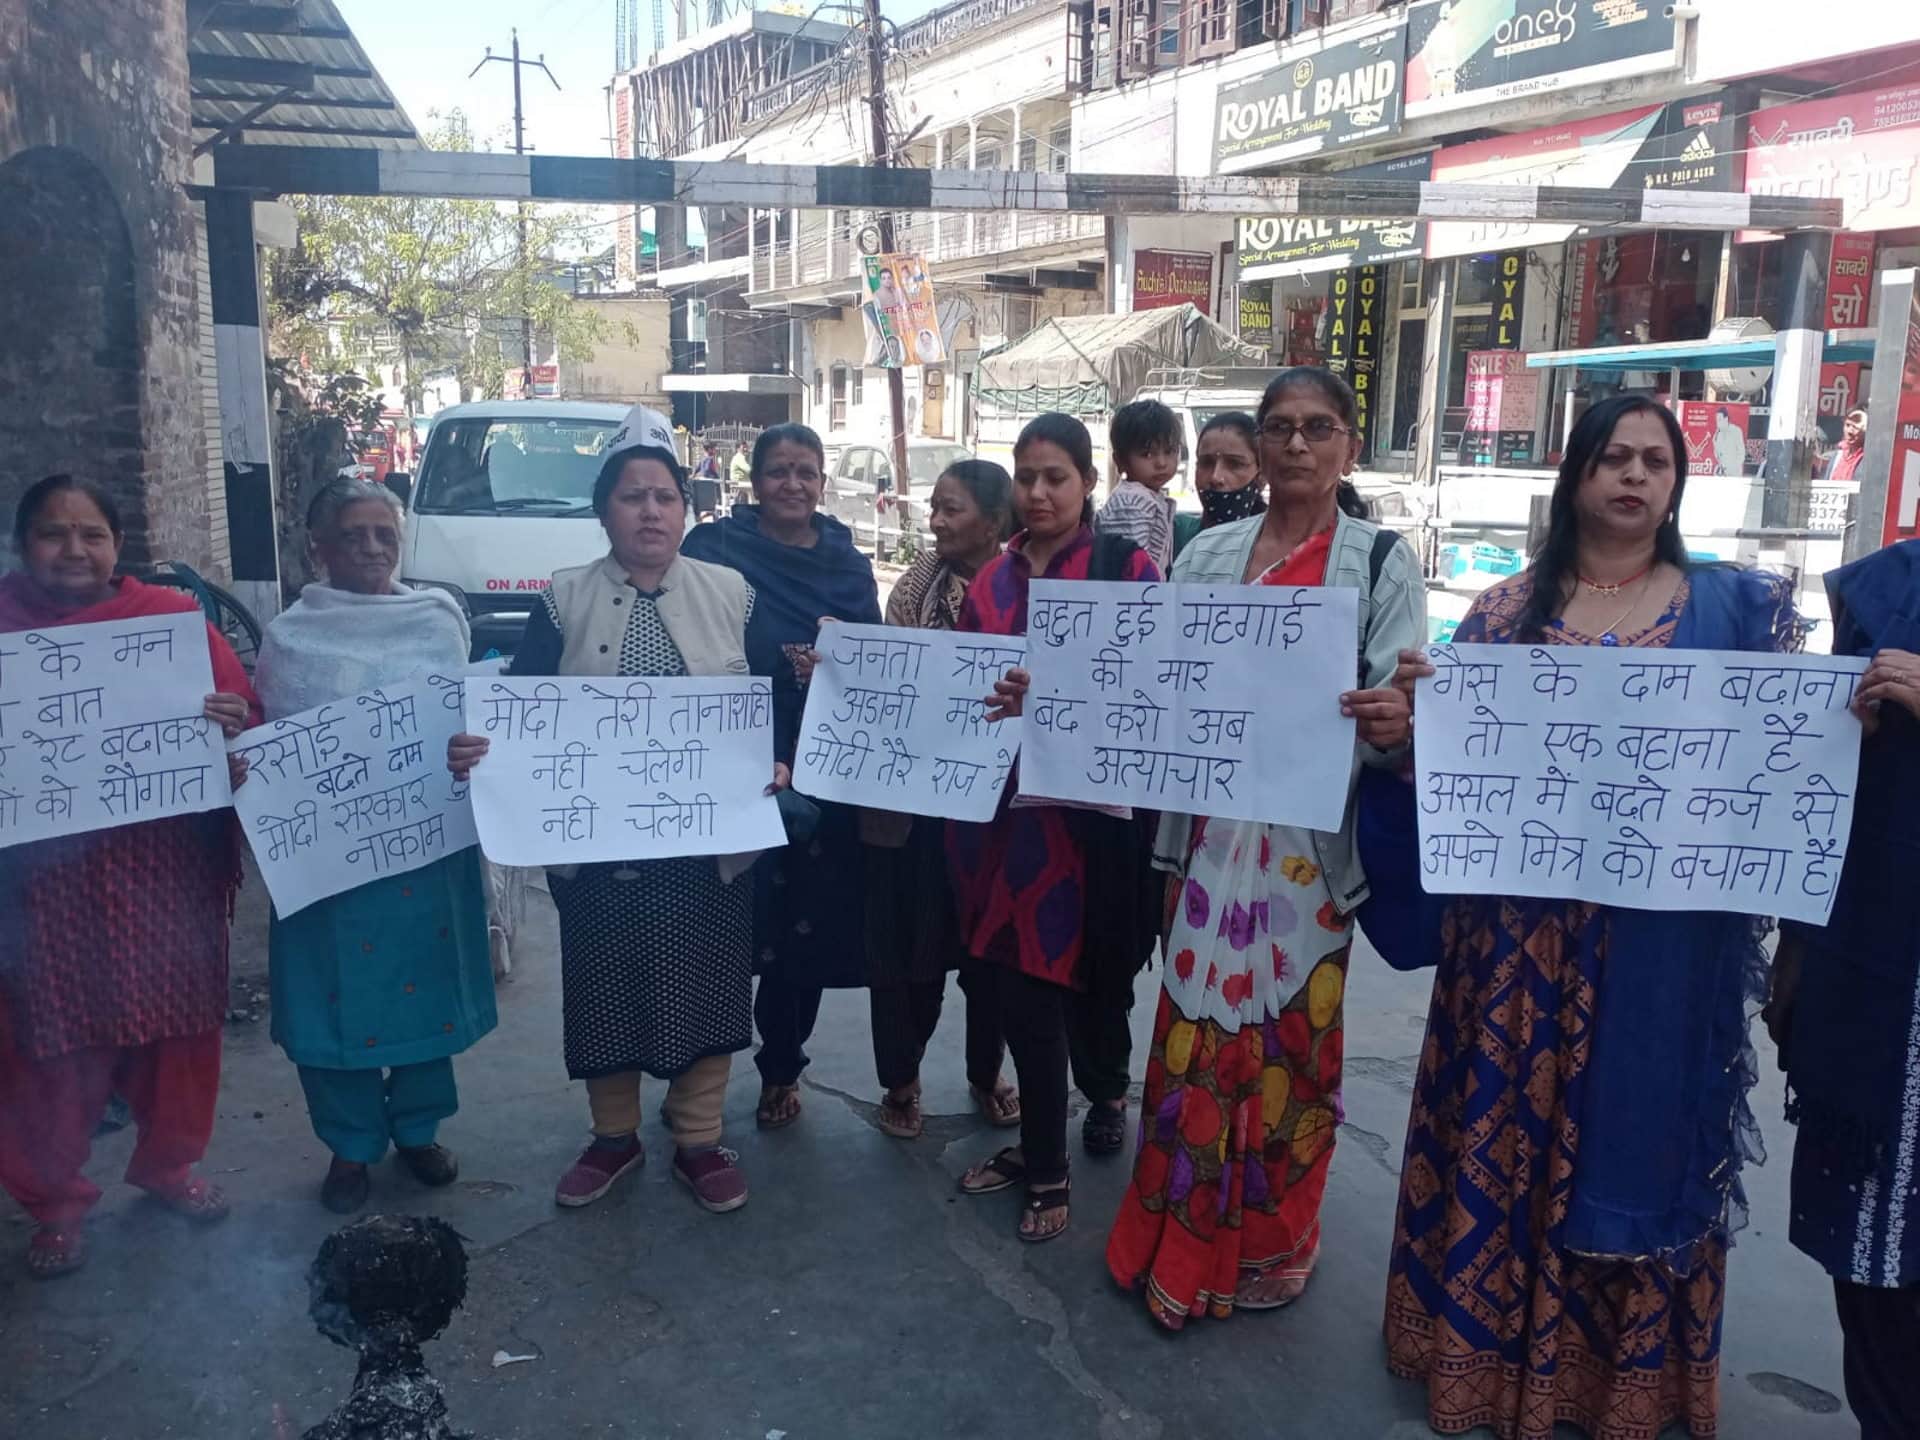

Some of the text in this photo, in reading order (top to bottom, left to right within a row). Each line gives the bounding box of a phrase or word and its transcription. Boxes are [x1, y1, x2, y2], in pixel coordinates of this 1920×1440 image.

[1219, 59, 1396, 141] ROYAL BAND
[1218, 142, 1242, 158] Special
[1242, 131, 1283, 151] Arrangement
[1283, 125, 1300, 141] For
[1300, 118, 1332, 136] Wedding
[1680, 147, 1716, 163] adidas
[1787, 116, 1856, 150] साबरी
[1238, 217, 1333, 251] ROYAL
[1239, 237, 1361, 267] Special Arrangement For Wedding
[1834, 256, 1869, 278] साबरी
[1240, 299, 1272, 313] ROYAL
[1240, 313, 1271, 328] BAND
[1470, 354, 1503, 375] SALE
[486, 578, 552, 592] ON ARM
[1032, 599, 1099, 648] बहुत
[1108, 584, 1164, 648] हुई
[25, 632, 85, 681] के
[111, 628, 175, 669] मन
[832, 636, 931, 680] जनता
[1091, 648, 1215, 692] की मार
[1430, 645, 1503, 702] गैस
[1529, 648, 1583, 703] के
[1620, 664, 1696, 702] दाम
[38, 686, 105, 729] बात
[482, 683, 569, 740] मोदी
[581, 682, 658, 740] तेरी
[832, 683, 920, 730] अडानी
[1034, 688, 1255, 745] बंद करो अब
[22, 729, 86, 771] रेट
[231, 705, 347, 785] रसोई
[356, 689, 418, 742] गैस
[387, 740, 424, 775] दाम
[804, 723, 875, 781] मोदी
[878, 737, 921, 787] तेरे
[932, 756, 987, 798] राज
[1464, 705, 1824, 773] तो एक बहाना है
[532, 738, 710, 791] नहीं चलेगी
[1086, 746, 1243, 801] अत्याचार
[35, 774, 79, 822] को
[257, 772, 433, 862] मोदी सरकार
[541, 791, 719, 843] नहीं चलेगी
[1421, 771, 1520, 816] असल
[1537, 765, 1580, 815] में
[1687, 772, 1772, 831] कर्ज
[1793, 774, 1849, 836] से
[345, 812, 445, 873] नाकाम
[1422, 820, 1504, 878] अपने
[1520, 819, 1588, 881] मित्र
[1602, 826, 1663, 889] को
[1671, 843, 1794, 897] बचाना
